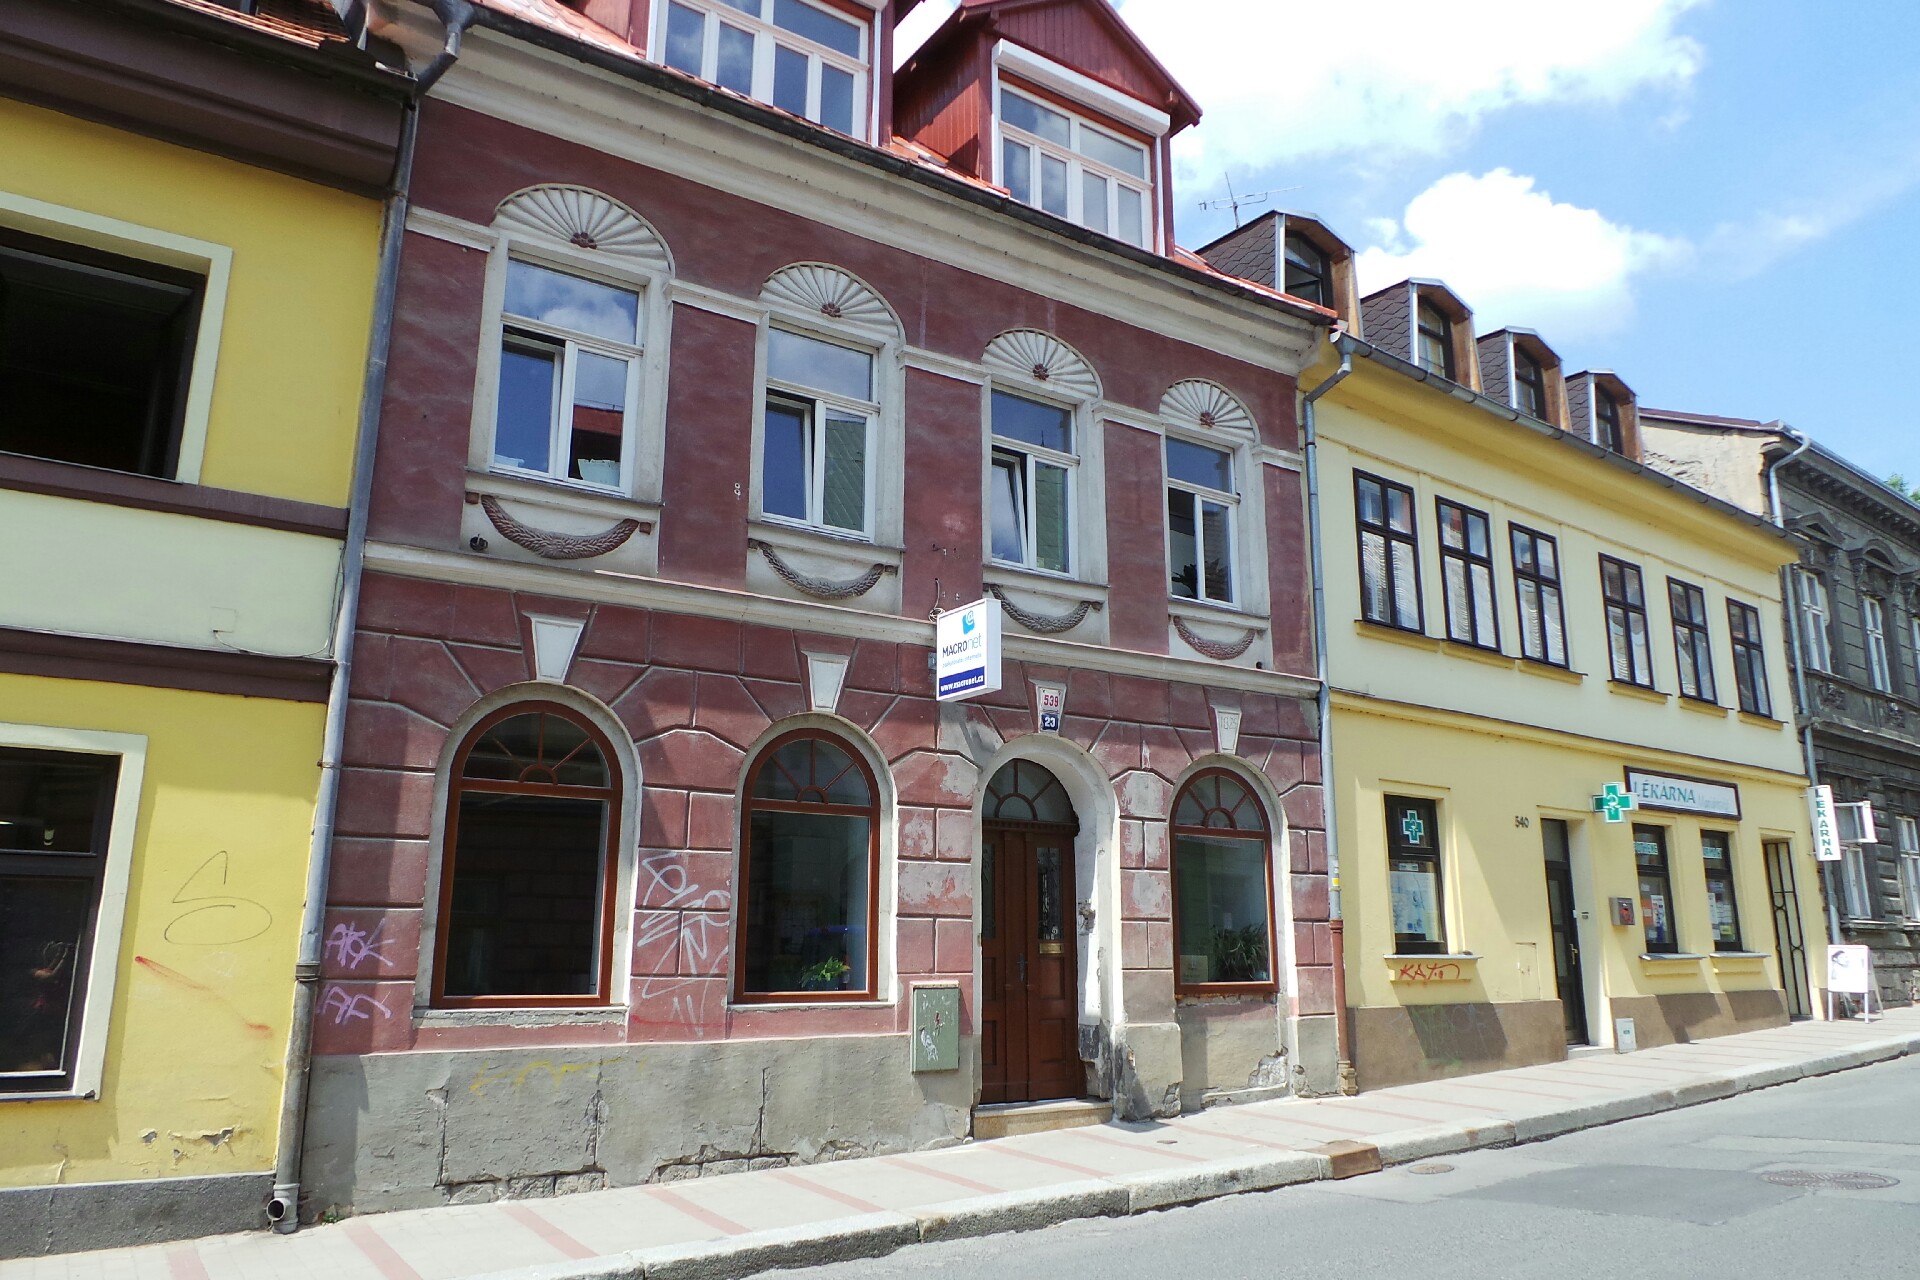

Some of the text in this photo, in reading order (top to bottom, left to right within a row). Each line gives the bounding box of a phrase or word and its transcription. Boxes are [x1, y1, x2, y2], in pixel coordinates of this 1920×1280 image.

[942, 633, 982, 658] MACROnet
[940, 675, 984, 693] www.macronet.cz
[1043, 694, 1059, 707] 539
[1044, 716, 1056, 728] 23
[1514, 815, 1530, 829] 540
